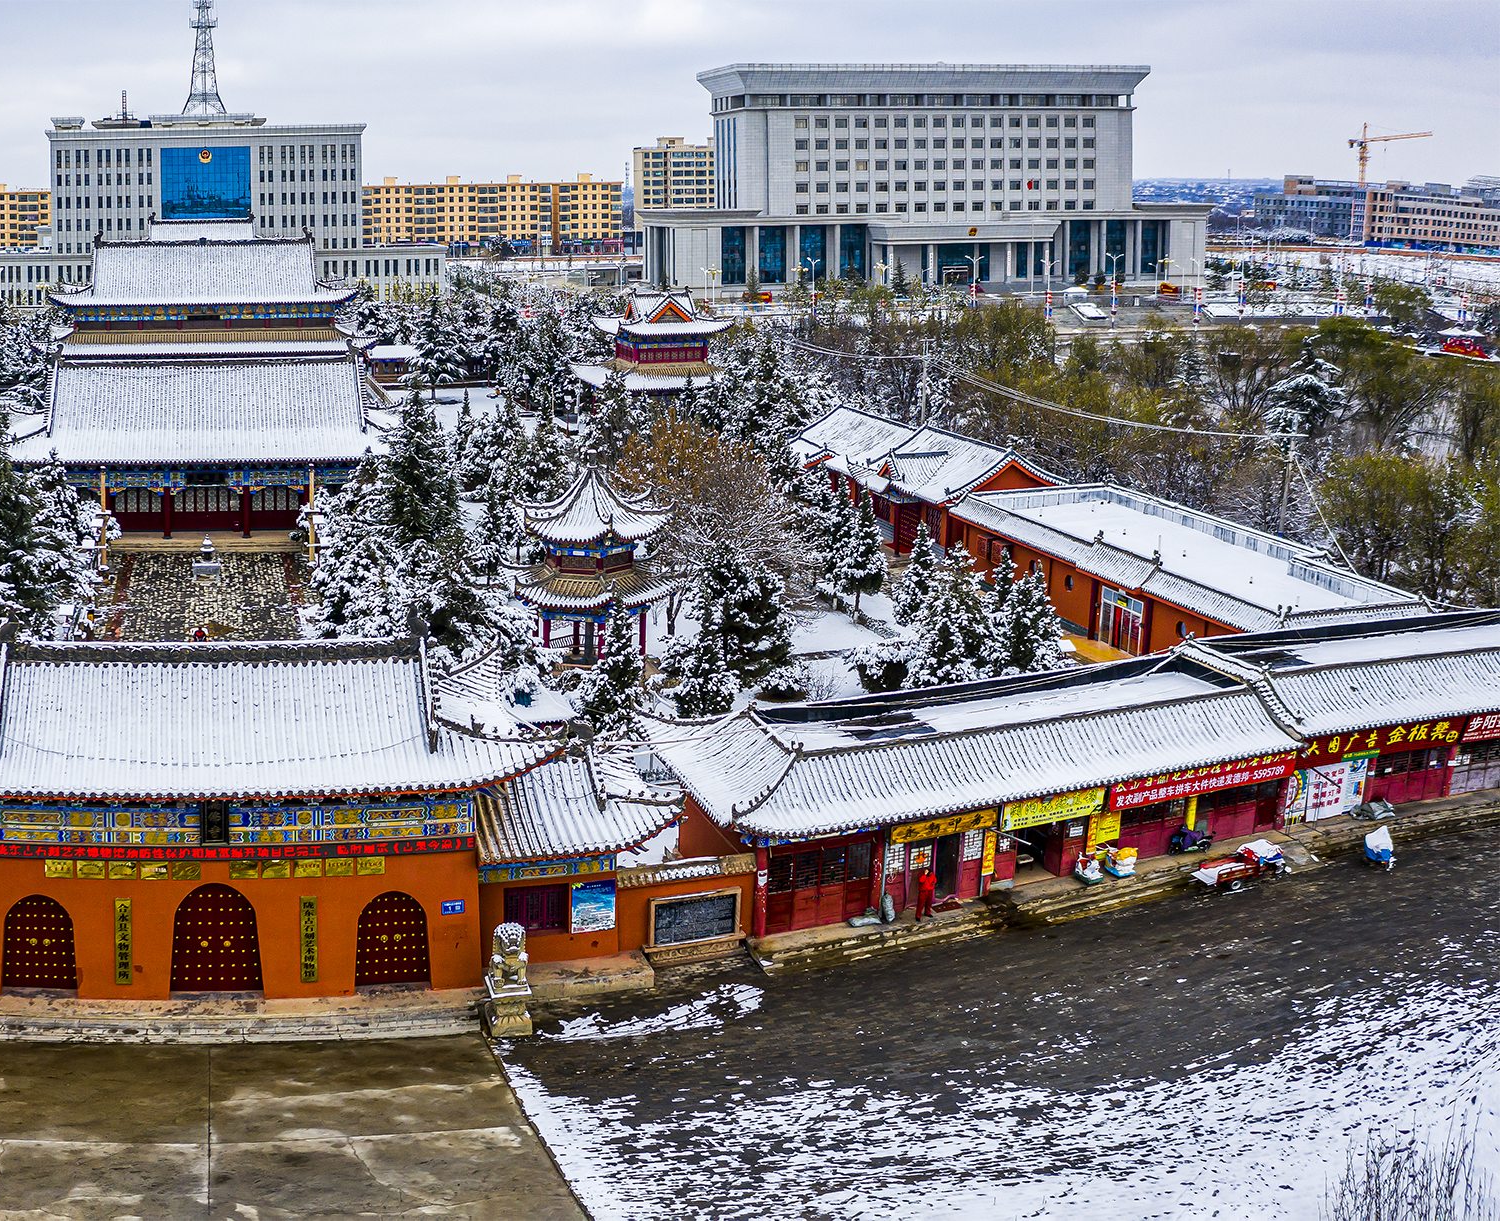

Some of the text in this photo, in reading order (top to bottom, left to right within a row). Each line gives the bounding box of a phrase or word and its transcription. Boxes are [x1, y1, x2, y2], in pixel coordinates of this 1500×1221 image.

[1467, 714, 1500, 732] 步阳
[118, 903, 130, 980] 合水县文物管理所
